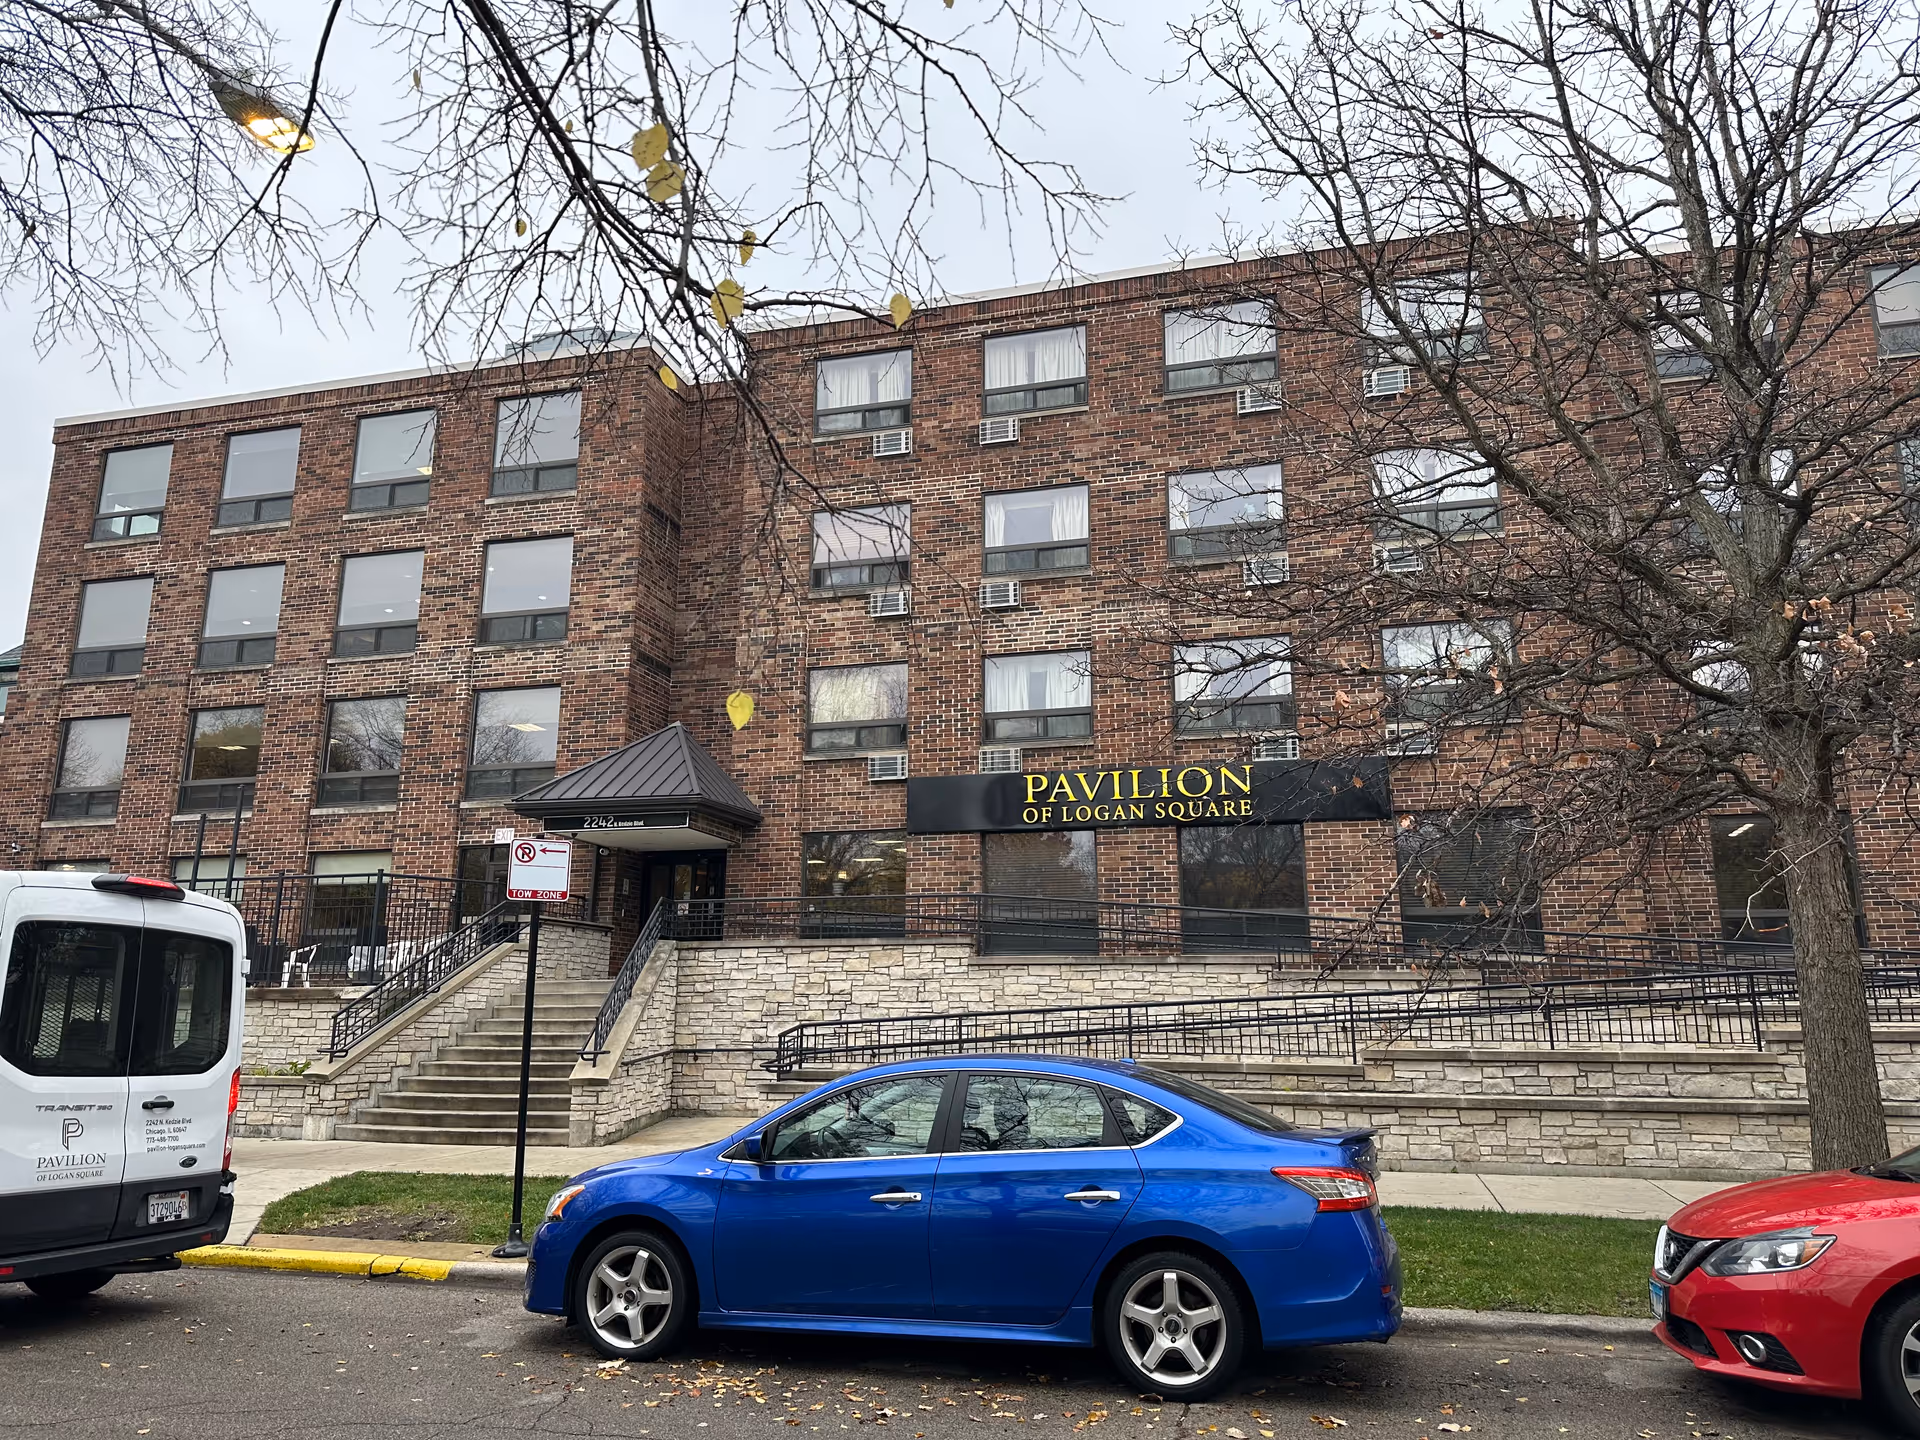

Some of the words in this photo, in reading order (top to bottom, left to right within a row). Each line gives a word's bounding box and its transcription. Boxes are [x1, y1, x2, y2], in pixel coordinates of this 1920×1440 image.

[1023, 765, 1254, 803] PAVILION
[1022, 807, 1052, 823] OF
[1061, 803, 1145, 822] LOGAN
[1155, 798, 1253, 822] SQUARE
[583, 815, 614, 828] 2242
[495, 829, 514, 842] EXIT
[511, 889, 532, 899] TOW
[536, 890, 563, 900] ZONE
[35, 1104, 96, 1112] TRANSIT
[147, 1144, 206, 1152] pavilion-logansquare.com
[37, 1153, 106, 1168] PAVILION
[36, 1174, 48, 1182] OF
[48, 1172, 74, 1180] LOGAN
[76, 1170, 103, 1179] SQUARE
